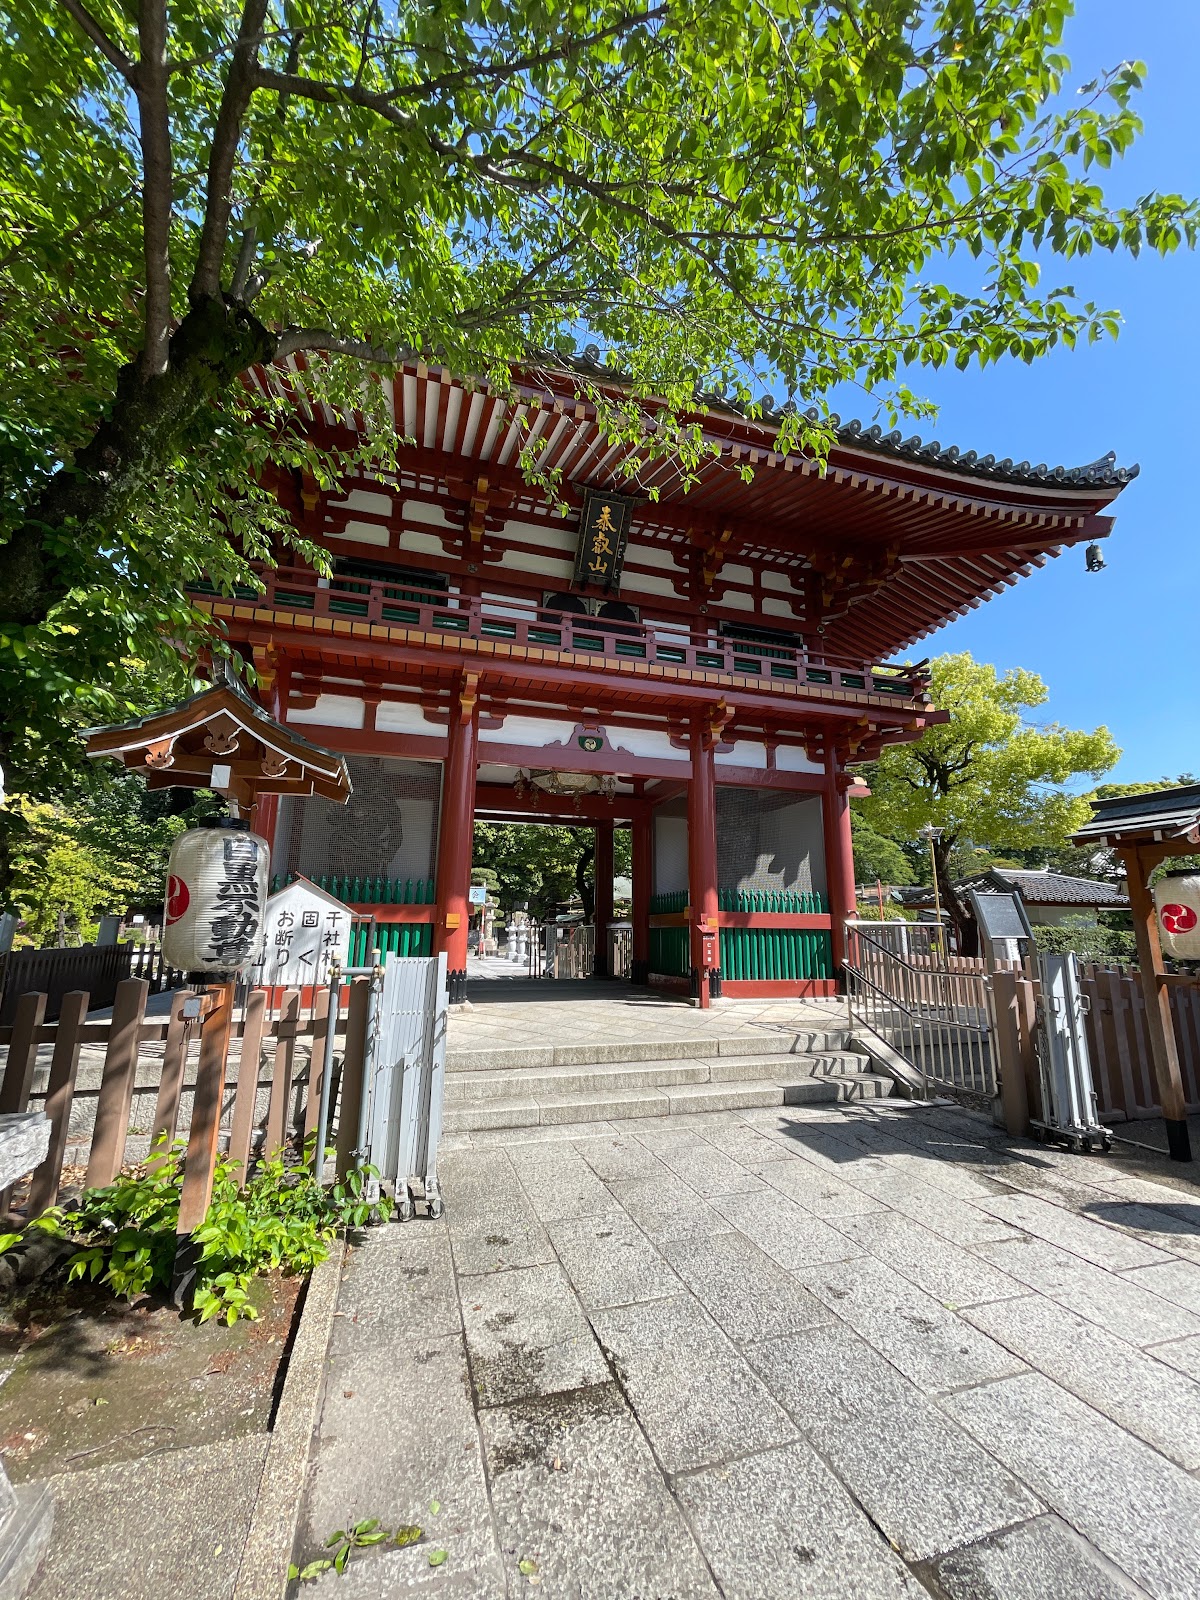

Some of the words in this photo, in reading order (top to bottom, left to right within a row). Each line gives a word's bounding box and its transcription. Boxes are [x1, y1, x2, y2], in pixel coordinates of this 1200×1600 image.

[202, 838, 260, 966] 目黒不動尊
[275, 910, 295, 967] お断り
[298, 911, 319, 966] 固く
